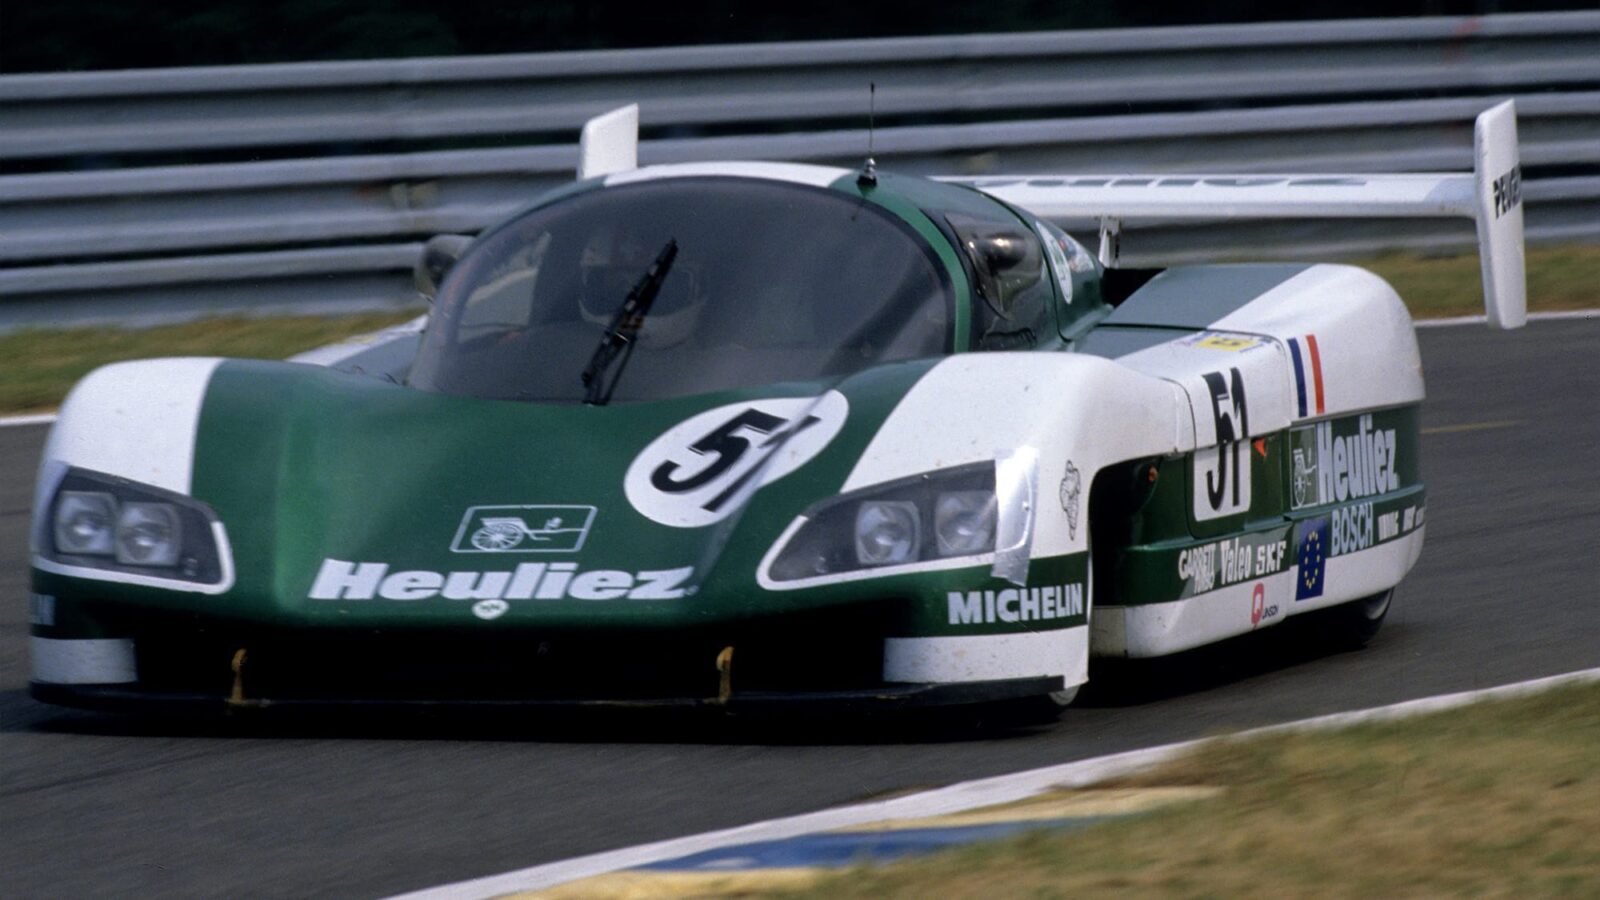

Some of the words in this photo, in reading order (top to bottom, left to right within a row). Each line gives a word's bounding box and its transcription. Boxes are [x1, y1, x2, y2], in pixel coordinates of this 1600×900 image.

[651, 408, 822, 512] 51
[1202, 367, 1248, 511] 51
[1316, 414, 1398, 505] Heuliez
[1331, 502, 1373, 557] BOSCH
[308, 559, 694, 600] Heuliez
[1221, 537, 1252, 585] Valeo
[1255, 541, 1287, 576] SKF
[948, 583, 1083, 625] MICHELIN
